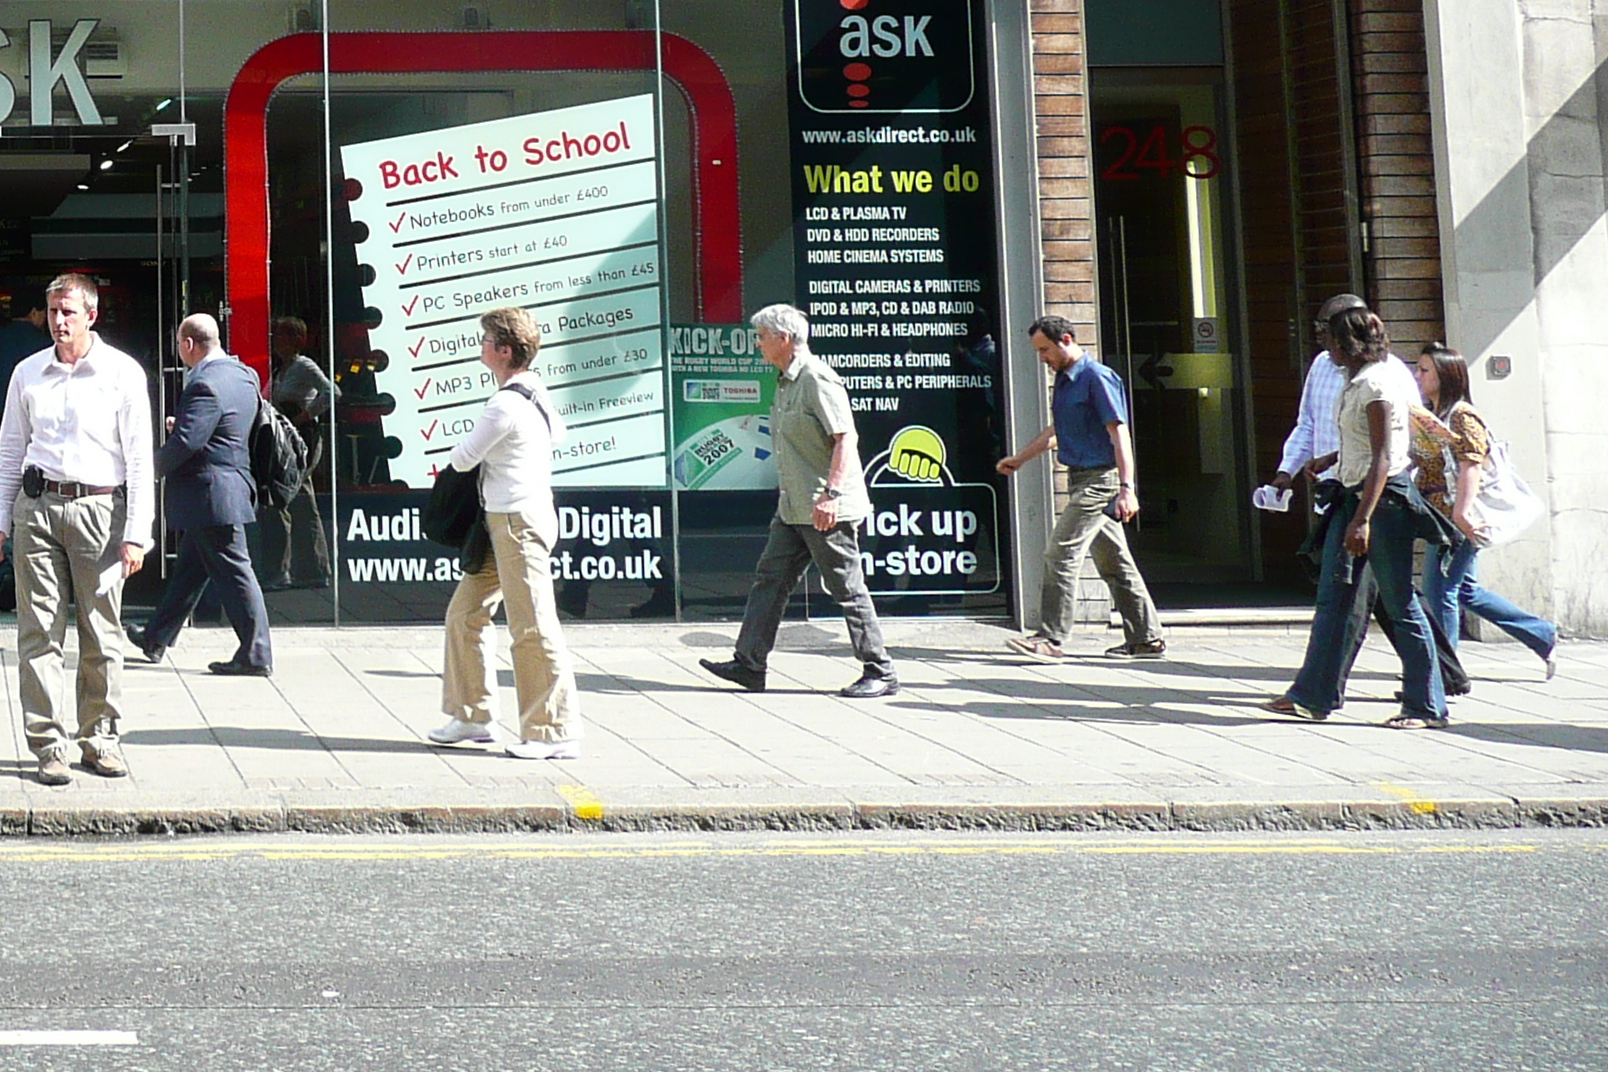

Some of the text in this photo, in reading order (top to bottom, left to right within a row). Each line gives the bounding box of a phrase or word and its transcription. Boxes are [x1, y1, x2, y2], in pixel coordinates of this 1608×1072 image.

[840, 15, 934, 57] ask
[802, 126, 975, 143] www.askdirect.co.uk
[379, 122, 630, 189] Back to School
[1099, 126, 1219, 180] 248
[804, 165, 978, 193] What we do
[410, 186, 608, 229] Notebooks from under £400
[806, 207, 906, 220] LCD & PLASMA TV
[807, 228, 939, 241] DVD & HDD RECORDERS
[417, 235, 567, 271] Printers start at £40
[808, 250, 943, 263] HOME CINEMA SYSTEMS
[423, 262, 654, 312] PC Speakers from less than £45
[809, 280, 980, 294] DIGITAL CAMERAS & PRINTERS
[810, 301, 974, 317] IPOD & MP3, CD & DAB RADIO
[429, 332, 483, 356] Digital
[558, 307, 634, 332] Packages
[671, 327, 759, 355] KICK-OF
[811, 323, 967, 337] MICRO HI-FI & HEADPHONES
[436, 376, 473, 396] MP3
[547, 362, 577, 376] from
[581, 353, 617, 370] under
[623, 348, 648, 364] £30
[819, 353, 950, 369] AMCORDERS & EDITING
[723, 387, 758, 395] TOSHIBA
[840, 375, 991, 390] PUTERS & PC PERIPHERALS
[442, 391, 655, 437] LCD uilt-in Freeview
[851, 398, 899, 412] SAT NAV
[550, 436, 617, 461] n-store!
[703, 439, 736, 467] 2007
[346, 506, 662, 547] Audi Digital
[867, 503, 977, 543] ick up
[346, 549, 663, 582] www.asct.co.uk
[859, 544, 977, 576] n-store
